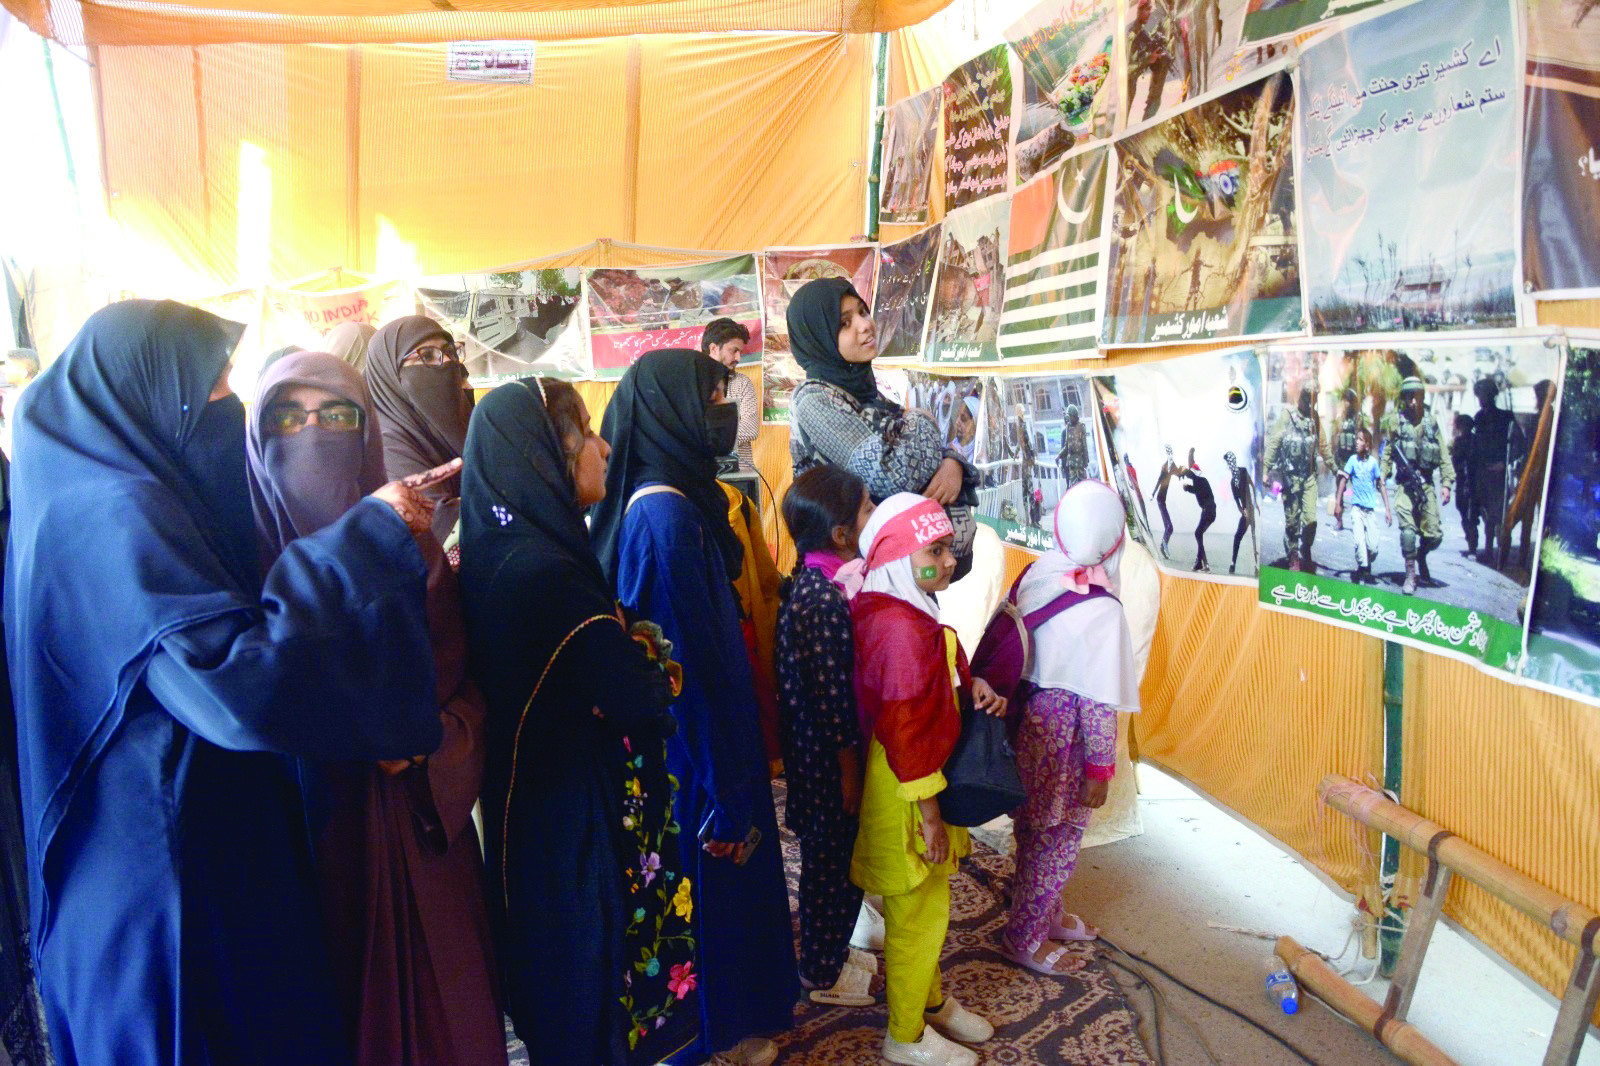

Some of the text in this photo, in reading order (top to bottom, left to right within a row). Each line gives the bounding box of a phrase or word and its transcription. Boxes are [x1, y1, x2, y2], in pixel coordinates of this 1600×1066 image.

[1433, 40, 1472, 82] کشمیر
[1479, 38, 1500, 67] اے
[1369, 78, 1399, 95] جنت
[1402, 63, 1429, 90] تیری
[1433, 90, 1475, 126] شعاروں
[1479, 87, 1505, 114] ستم
[1417, 112, 1433, 132] سے
[322, 299, 369, 323] INDIA
[1150, 305, 1229, 342] شعبہ امور کشمیر
[1271, 584, 1296, 605] ہے
[1316, 595, 1340, 610] سے
[1339, 597, 1372, 624] بچوں
[1369, 602, 1384, 623] جو
[1382, 610, 1407, 633] ہے
[1406, 608, 1437, 635] پھرتا
[1434, 614, 1450, 640] بنا
